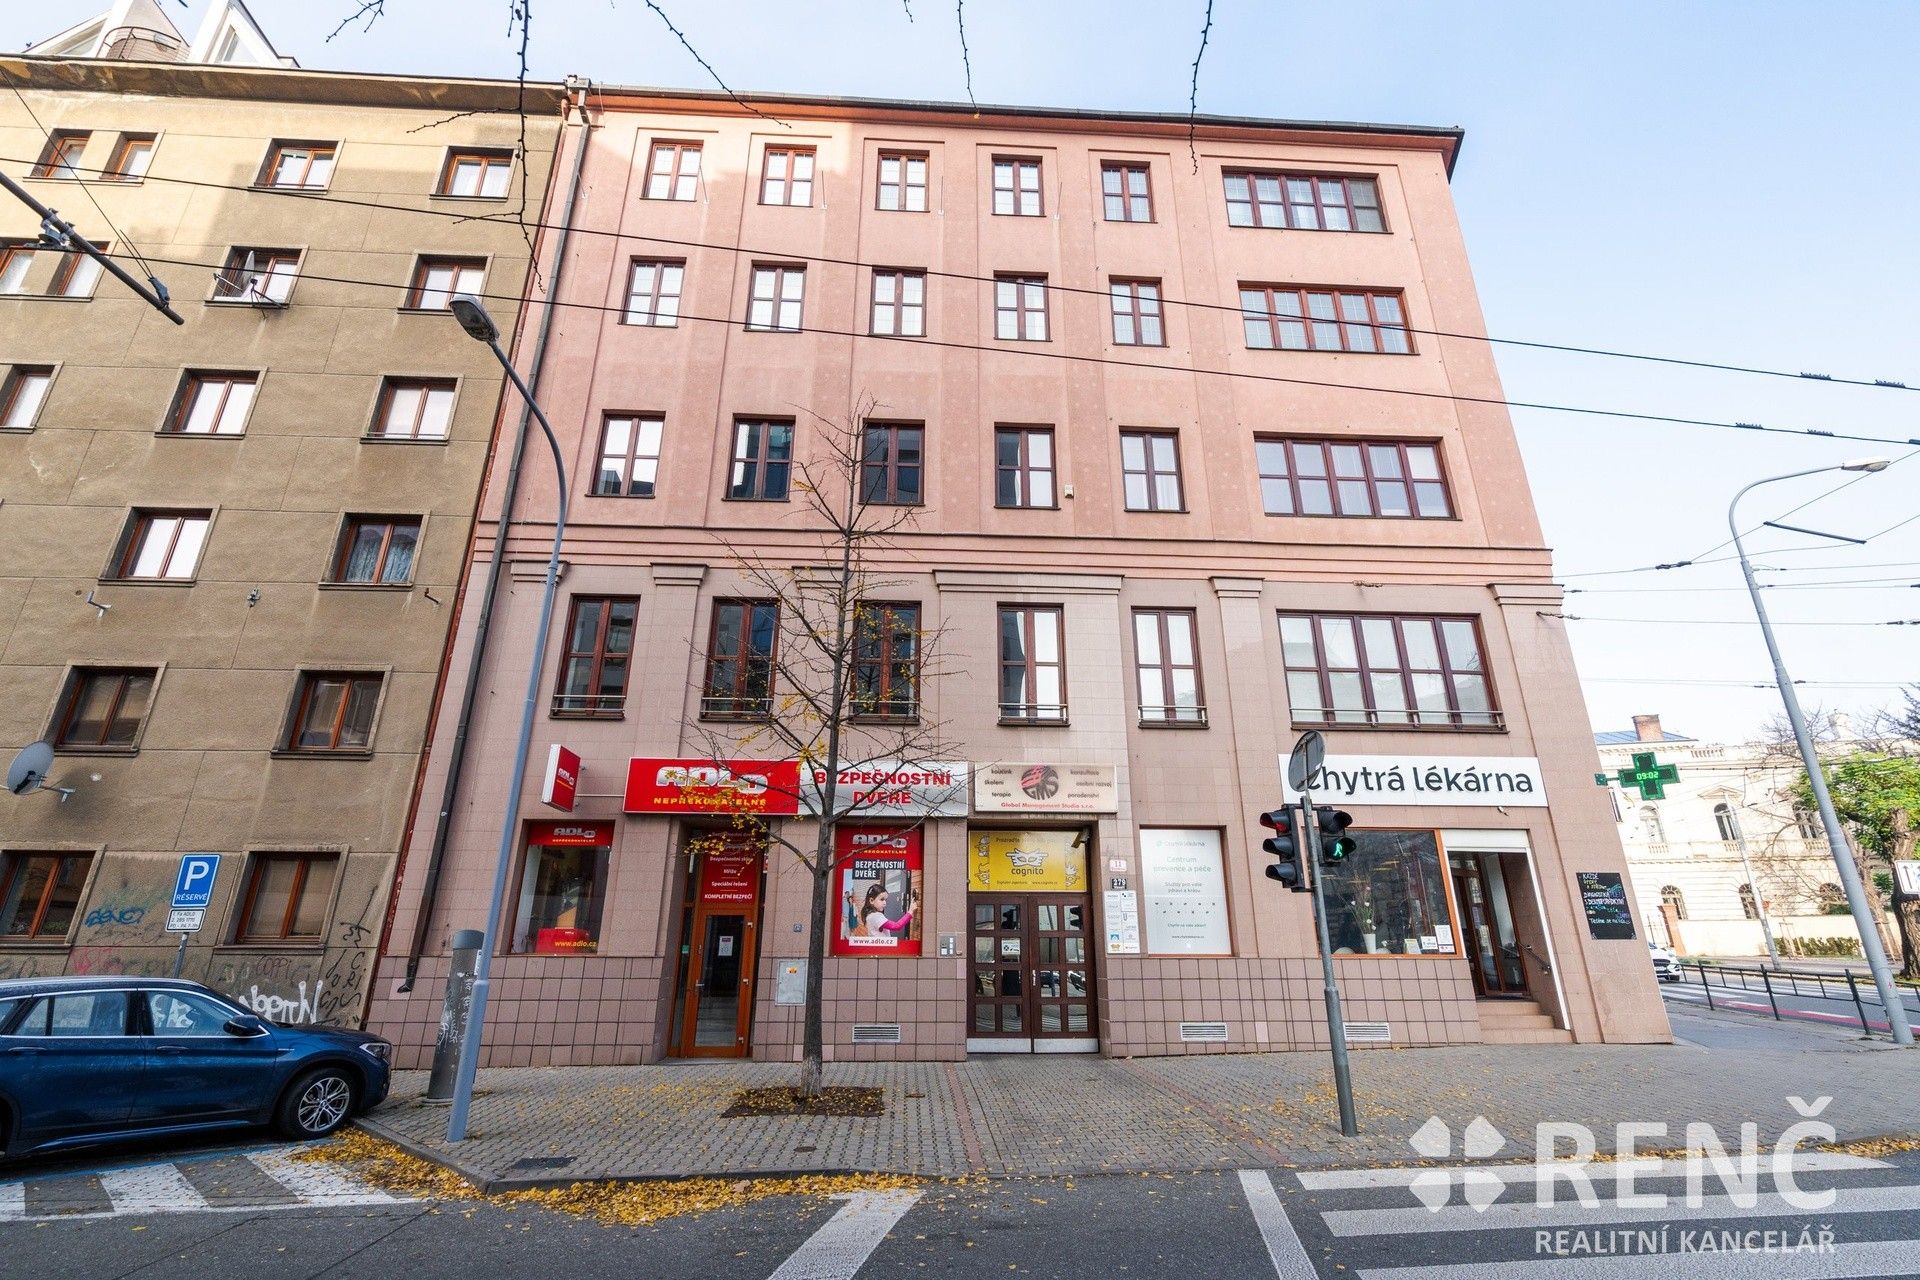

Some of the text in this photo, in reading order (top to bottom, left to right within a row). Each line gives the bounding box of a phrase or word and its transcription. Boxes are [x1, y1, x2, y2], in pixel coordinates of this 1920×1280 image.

[656, 766, 768, 794] ADLO
[815, 768, 952, 786] BZPEČNOSTNÍ
[1307, 765, 1533, 795] hytrá lékárna
[1636, 771, 1659, 780] 09:02
[853, 788, 912, 805] DVEŘE
[553, 828, 596, 838] ADLO
[852, 834, 907, 848] ADLO
[855, 859, 905, 869] BEZPEČNOSTNÍ
[184, 861, 209, 890] P
[855, 868, 877, 878] DVEŘE
[1011, 868, 1044, 877] cognito
